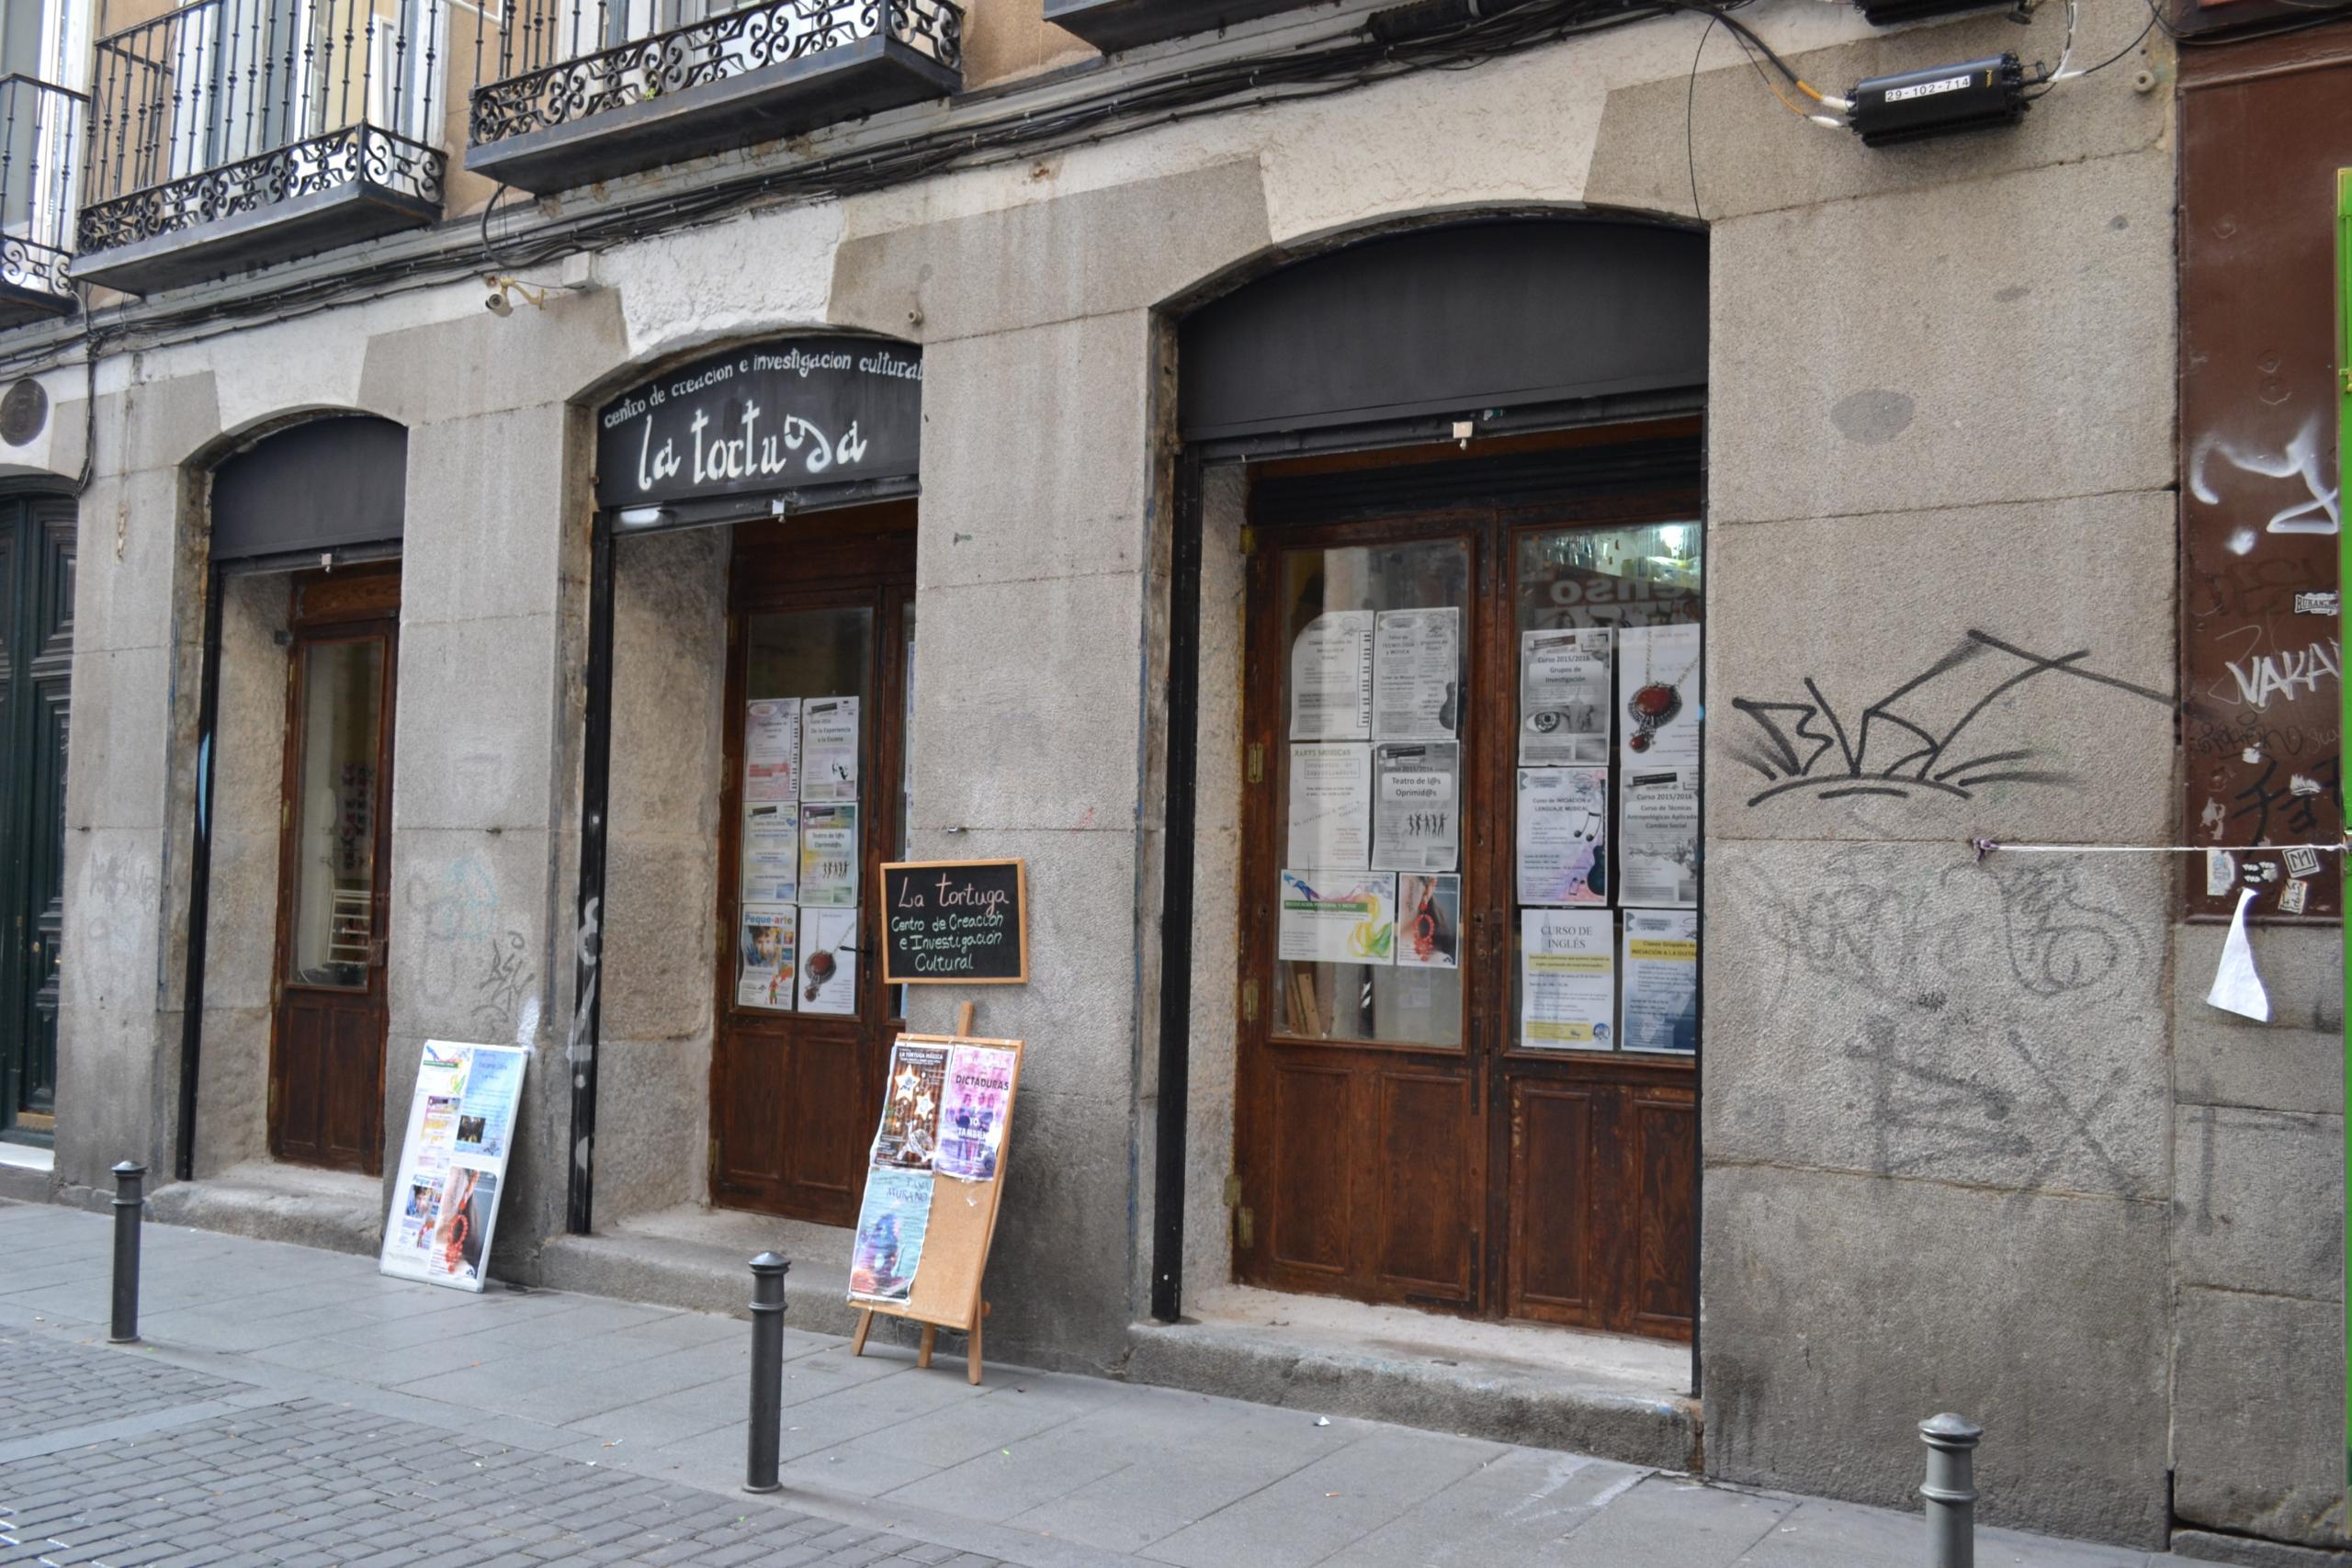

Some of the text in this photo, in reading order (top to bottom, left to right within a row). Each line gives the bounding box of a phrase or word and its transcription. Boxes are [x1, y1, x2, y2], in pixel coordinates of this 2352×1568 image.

[1886, 77, 1971, 102] 29-102-714
[604, 398, 646, 429] centro
[650, 385, 666, 409] de
[671, 364, 733, 396] creacion
[739, 359, 749, 374] e
[753, 348, 851, 378] investigacion
[639, 413, 681, 491] la
[1396, 789, 1437, 798] Oprimid@s
[899, 875, 925, 908] La
[891, 916, 925, 932] Centro
[932, 917, 947, 932] de
[1541, 925, 1593, 936] CURSO DE
[899, 937, 909, 951] e
[1548, 936, 1587, 949] INGLÉS
[914, 953, 975, 972] Cultural
[956, 1074, 1010, 1091] DICTADURAS
